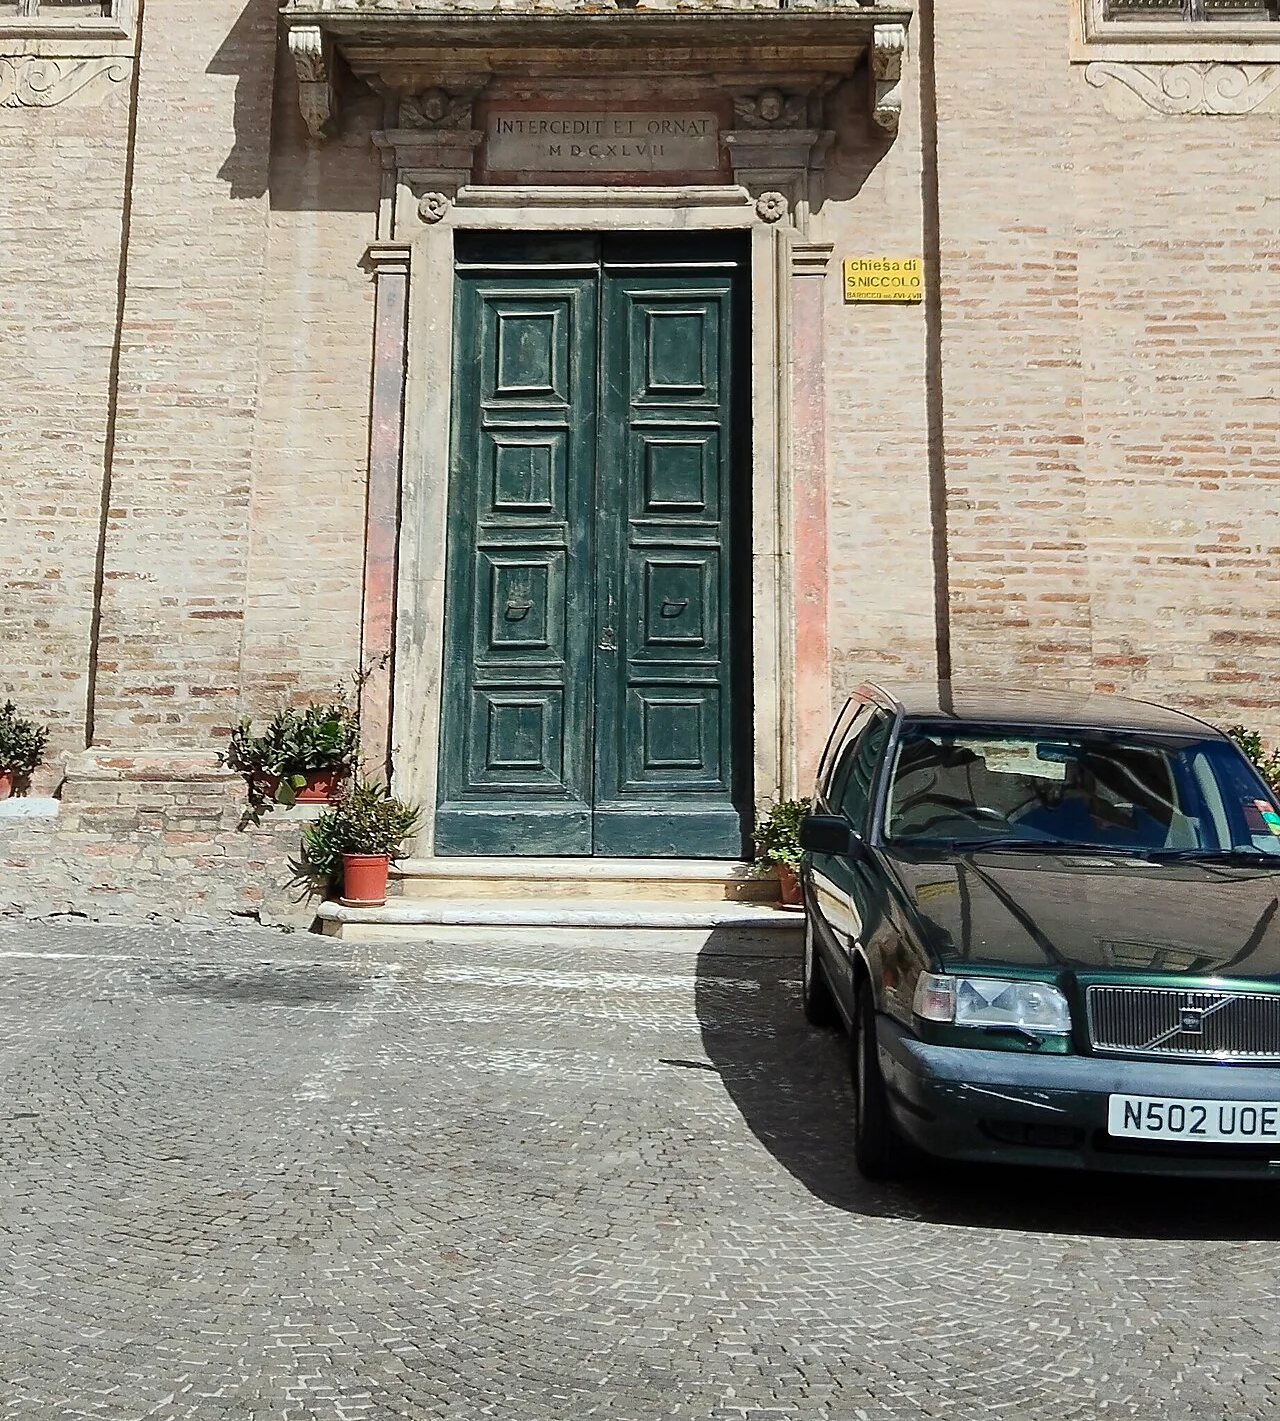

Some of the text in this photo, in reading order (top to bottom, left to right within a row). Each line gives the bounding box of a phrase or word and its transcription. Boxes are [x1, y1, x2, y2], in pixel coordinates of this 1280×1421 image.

[497, 118, 710, 135] INTERCEDIT ET ORNAT
[851, 260, 916, 271] chiesa di
[1124, 1101, 1278, 1136] N502 UOE
